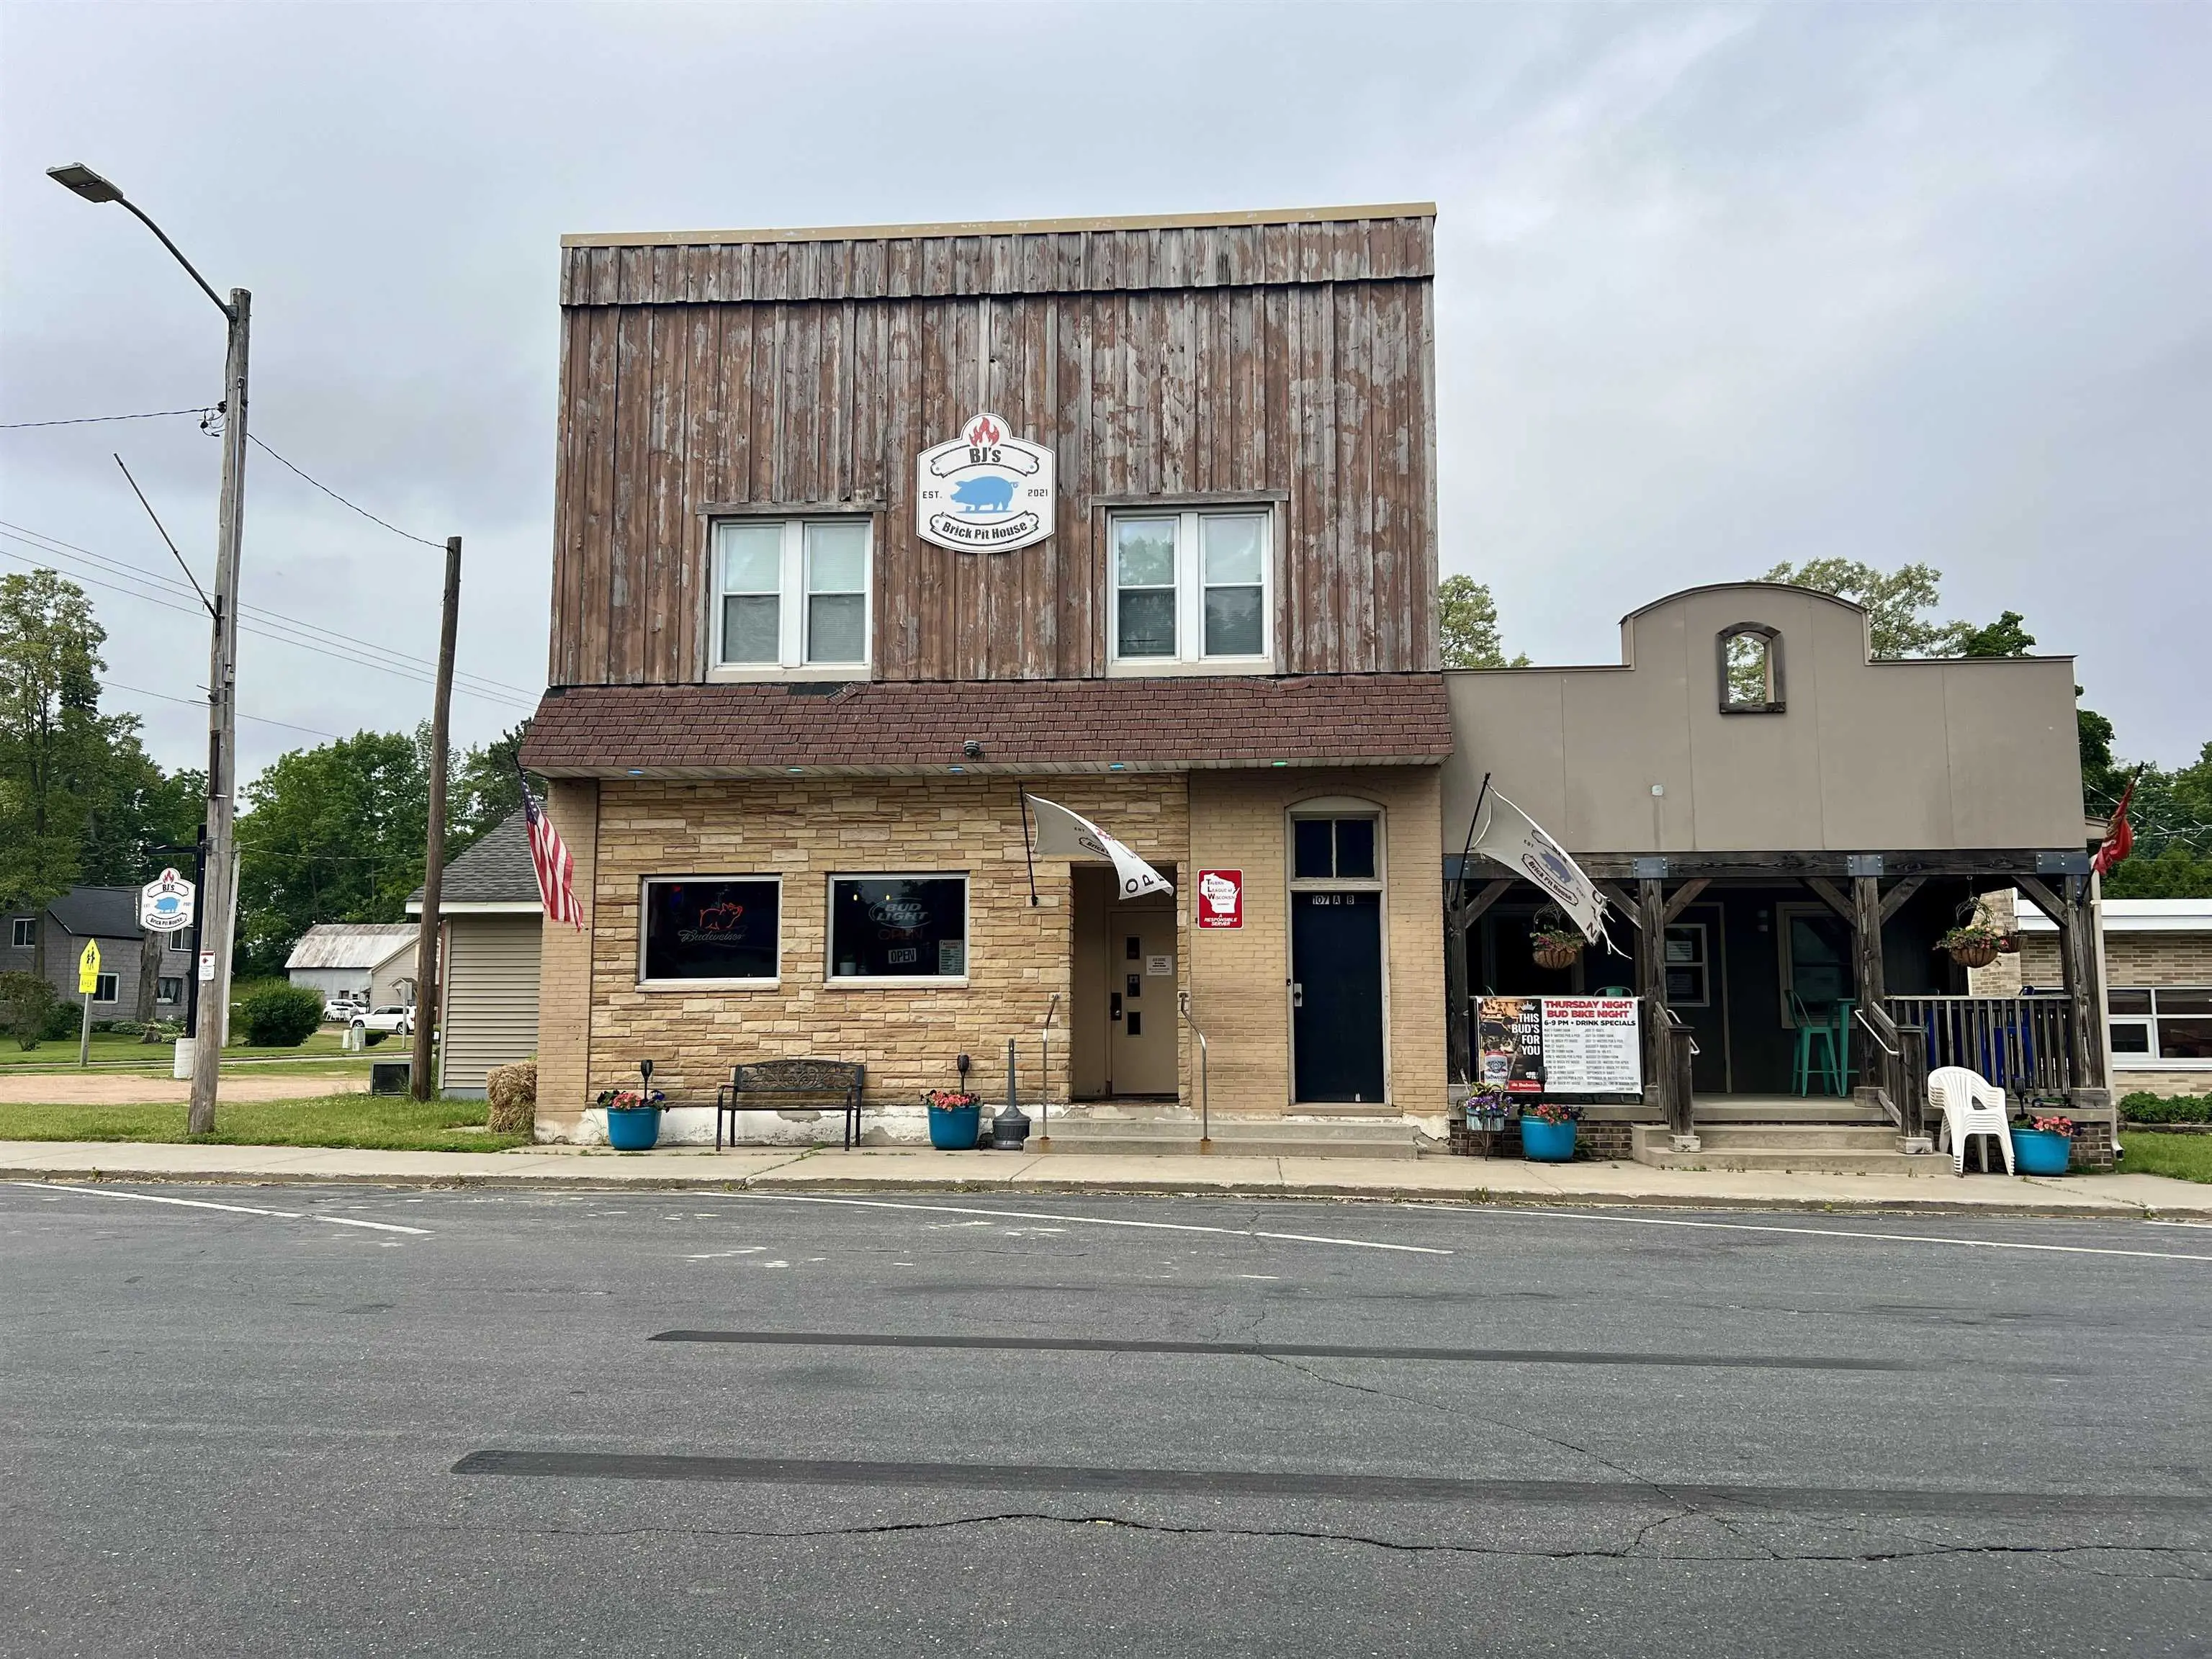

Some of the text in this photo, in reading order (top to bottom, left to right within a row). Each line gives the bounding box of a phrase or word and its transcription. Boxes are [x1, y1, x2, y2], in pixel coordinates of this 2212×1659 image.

[969, 447, 1002, 463] BJ's
[922, 490, 943, 499] EST.
[942, 521, 1028, 539] Brick Pit House
[1086, 841, 1106, 853] Brick
[1528, 861, 1545, 880] Brick
[1553, 883, 1573, 901] House
[1313, 895, 1354, 904] 107 A B
[885, 903, 922, 912] BUD
[876, 912, 928, 921] LIGHT
[678, 930, 744, 942] Budweiser
[891, 949, 915, 962] OPEN
[1519, 1013, 1539, 1022] THIS
[1511, 1024, 1539, 1034] BUD'S
[1521, 1035, 1540, 1045] FOR
[1521, 1045, 1540, 1056] YOU
